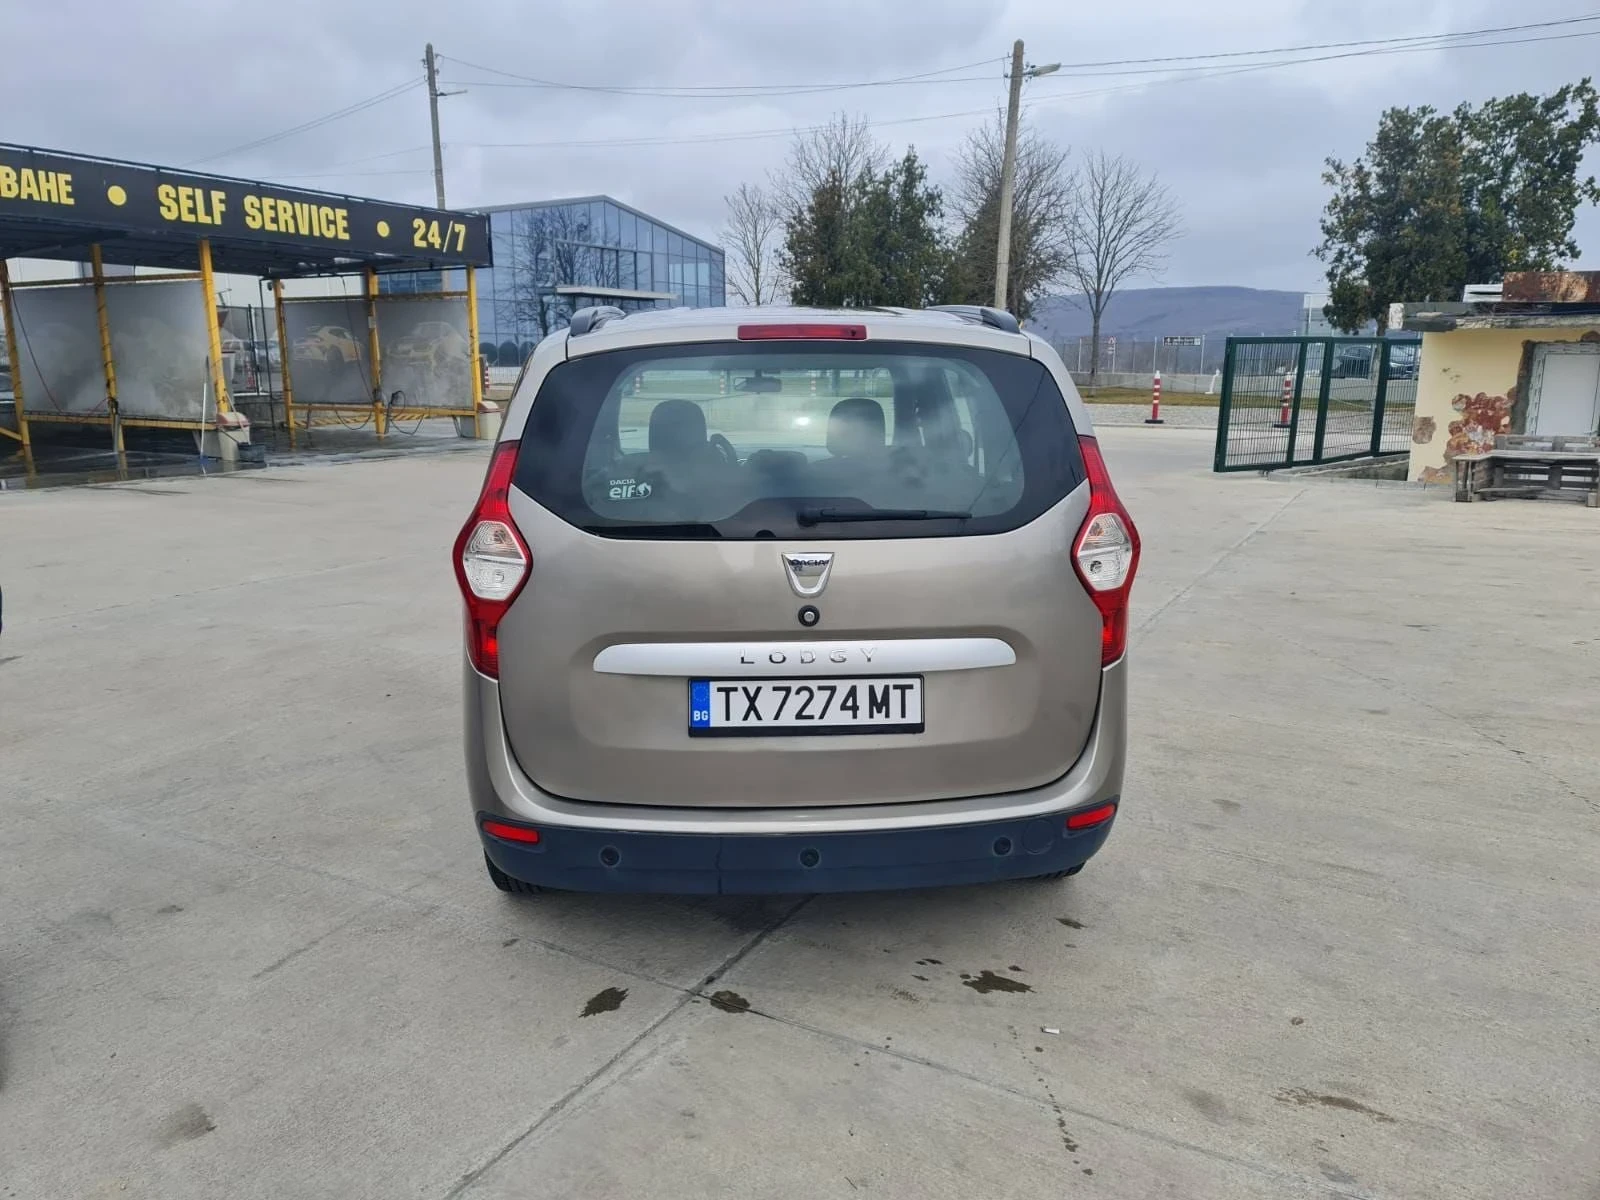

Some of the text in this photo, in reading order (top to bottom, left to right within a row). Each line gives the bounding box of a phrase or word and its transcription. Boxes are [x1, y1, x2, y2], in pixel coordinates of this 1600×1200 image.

[158, 184, 350, 240] SELF SERVICE
[413, 218, 467, 253] 24/7
[609, 478, 636, 486] DACIA
[609, 484, 636, 498] elf
[789, 558, 829, 566] DACIA
[740, 648, 878, 664] LODGY
[693, 710, 709, 721] BG
